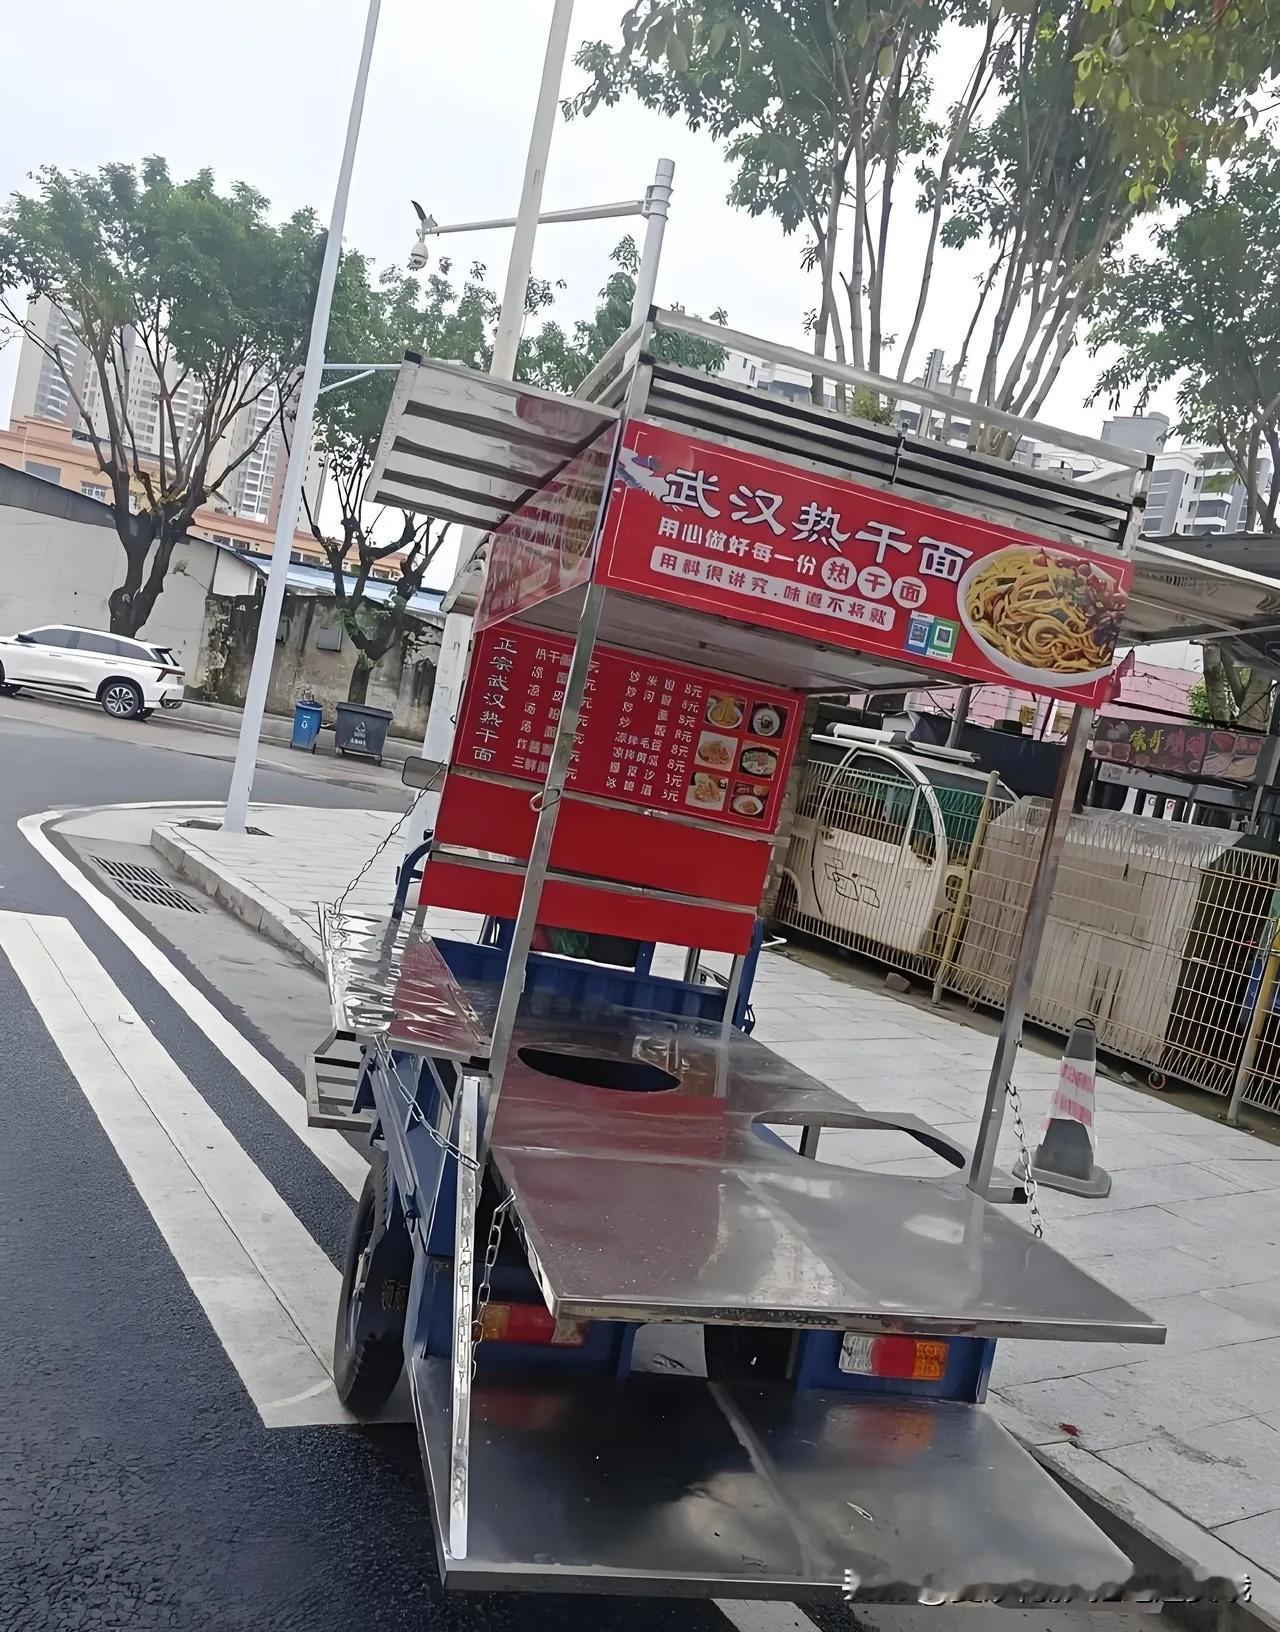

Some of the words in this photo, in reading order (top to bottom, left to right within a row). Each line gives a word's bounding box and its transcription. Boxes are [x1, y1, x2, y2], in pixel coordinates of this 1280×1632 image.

[661, 468, 974, 582] 武汉热干面
[472, 637, 518, 762] 正宗武汉热干面
